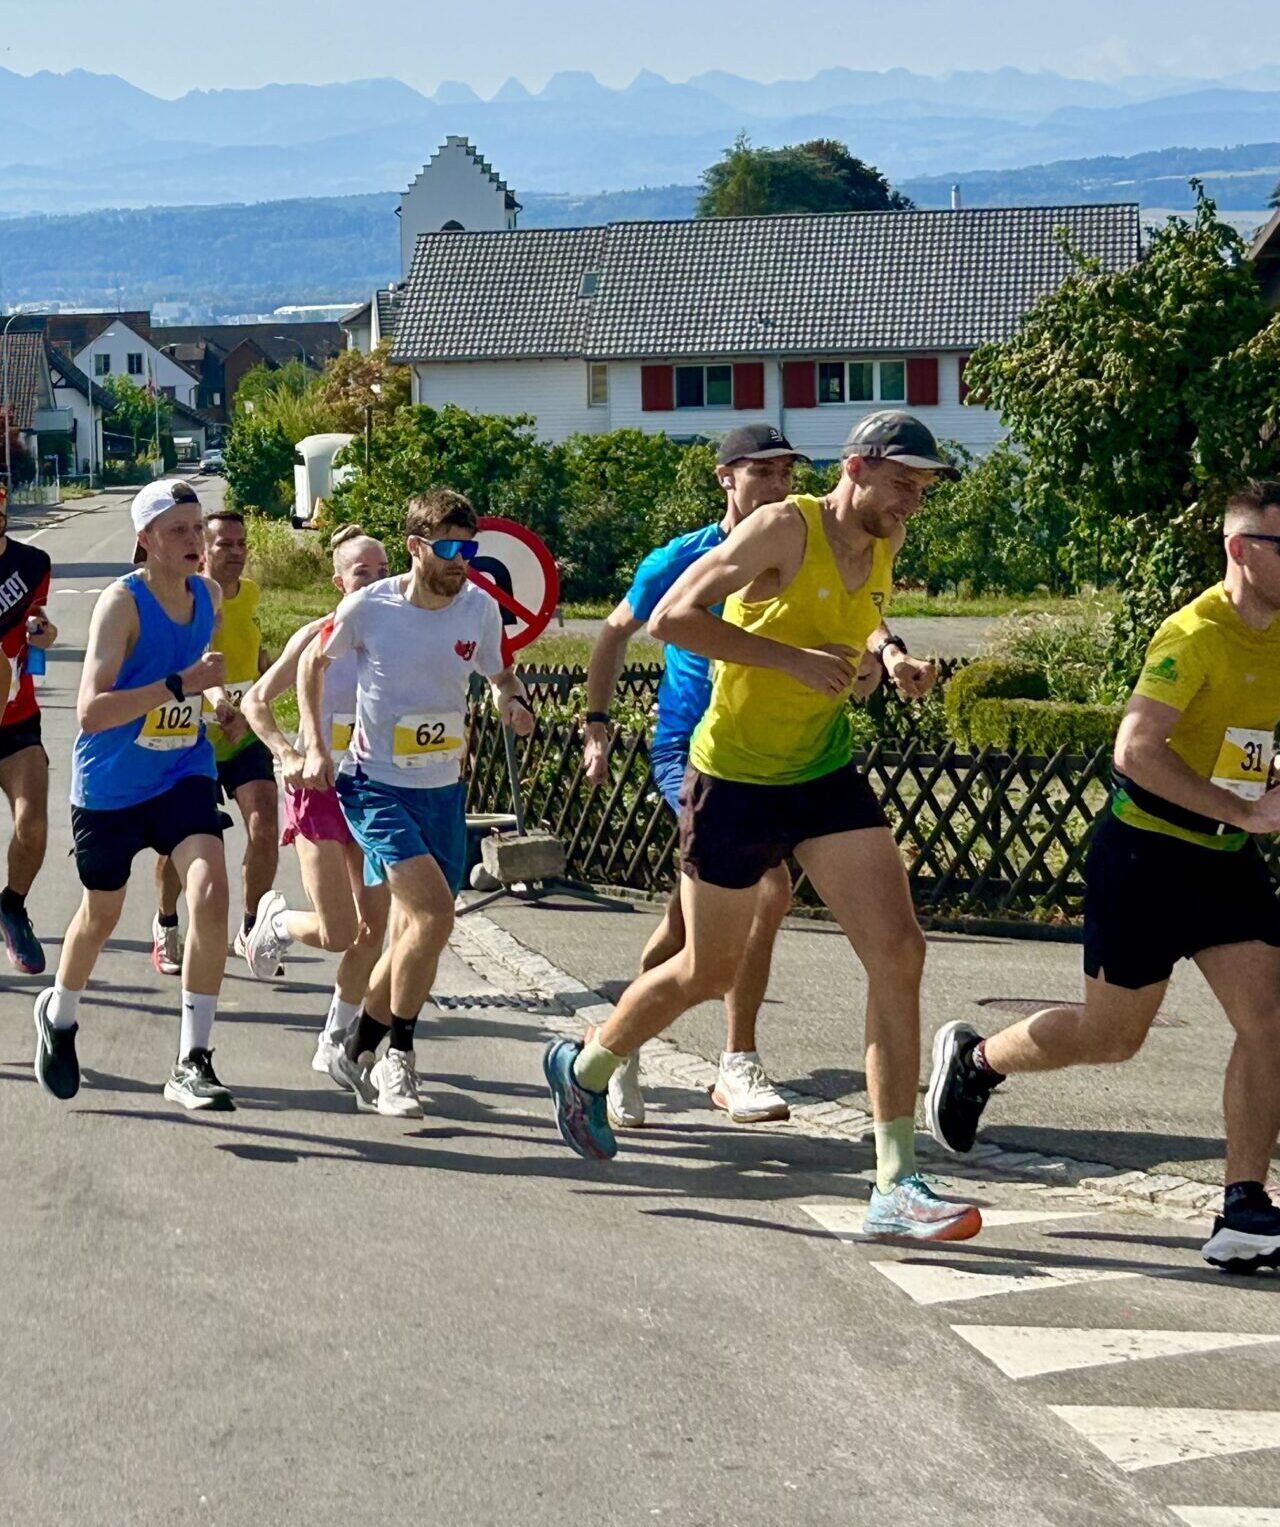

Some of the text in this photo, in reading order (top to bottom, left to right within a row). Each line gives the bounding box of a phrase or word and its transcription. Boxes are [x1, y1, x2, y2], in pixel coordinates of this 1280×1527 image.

[155, 706, 193, 729] 102
[416, 722, 446, 746] 62
[1241, 741, 1264, 772] 31
